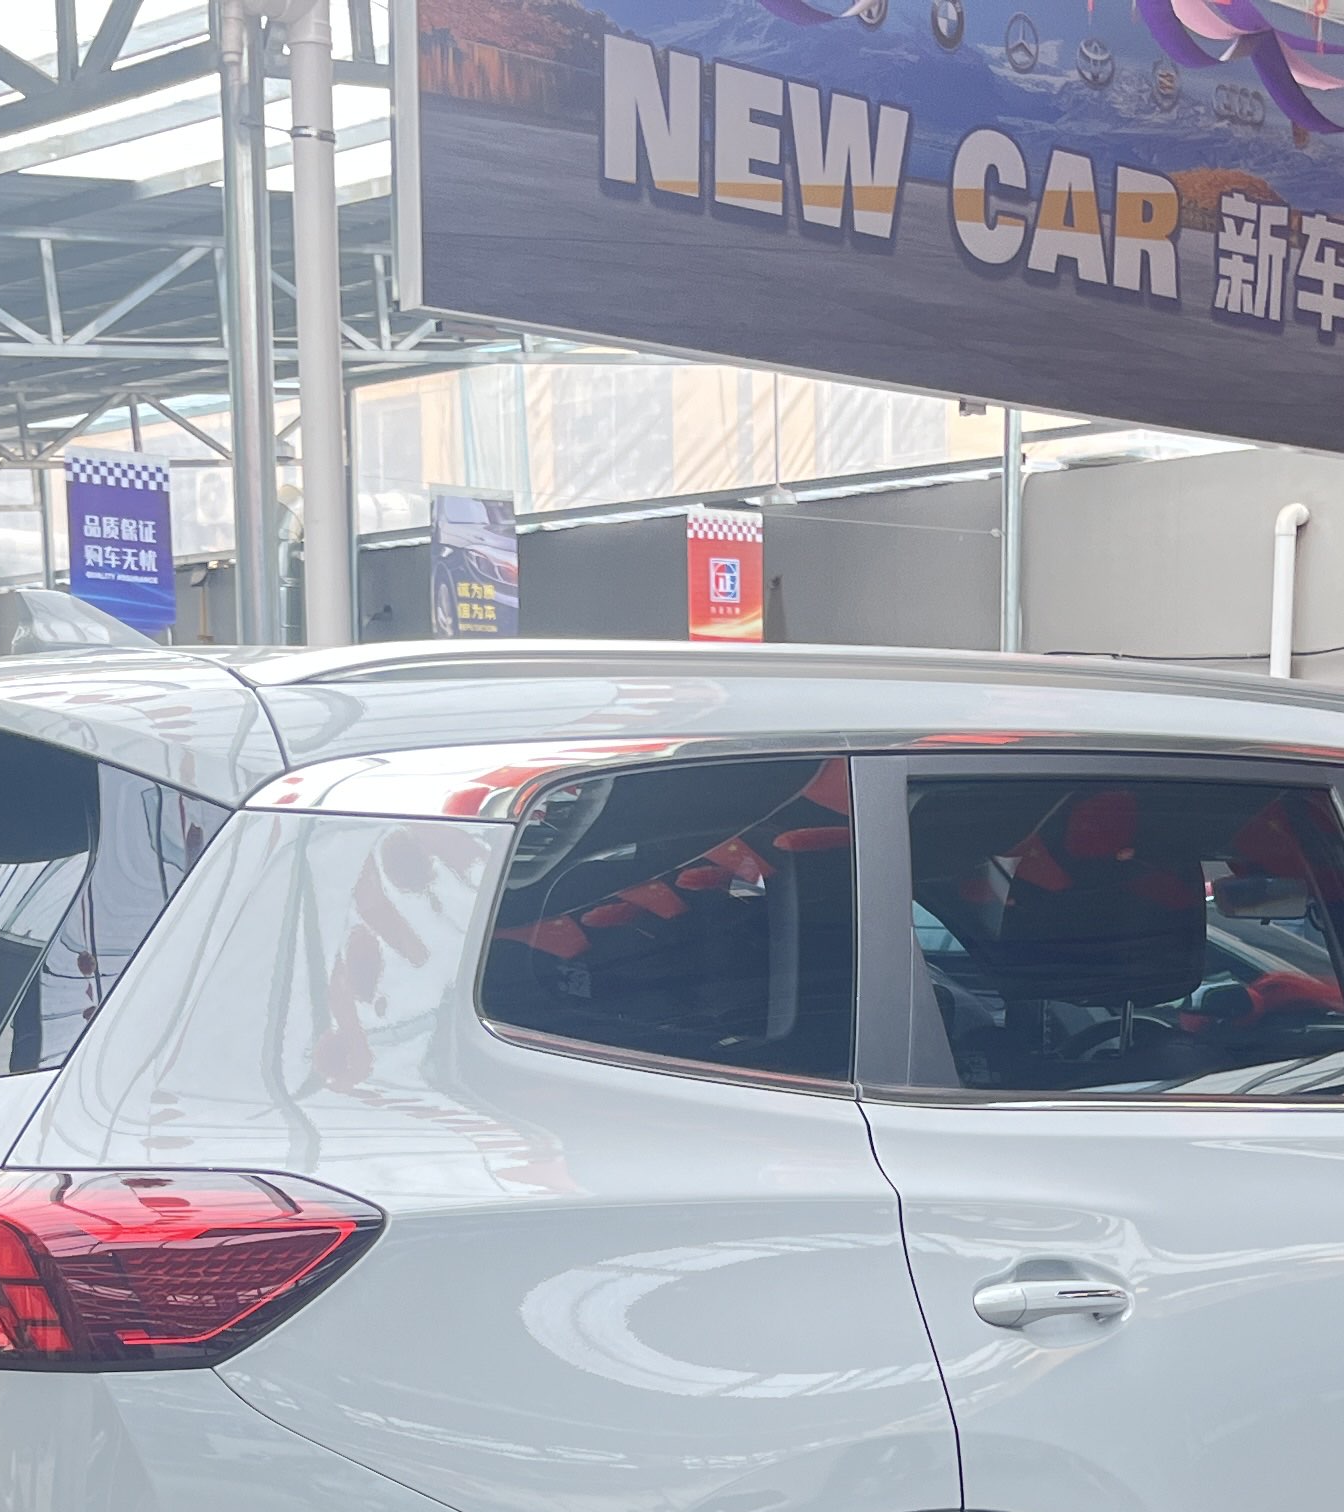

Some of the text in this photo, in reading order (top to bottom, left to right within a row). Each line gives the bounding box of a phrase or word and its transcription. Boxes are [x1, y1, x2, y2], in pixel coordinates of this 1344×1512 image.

[602, 32, 915, 240] NEW
[950, 127, 1182, 302] CAR
[83, 514, 157, 544] 品质保证
[84, 544, 159, 573] 购车无忧
